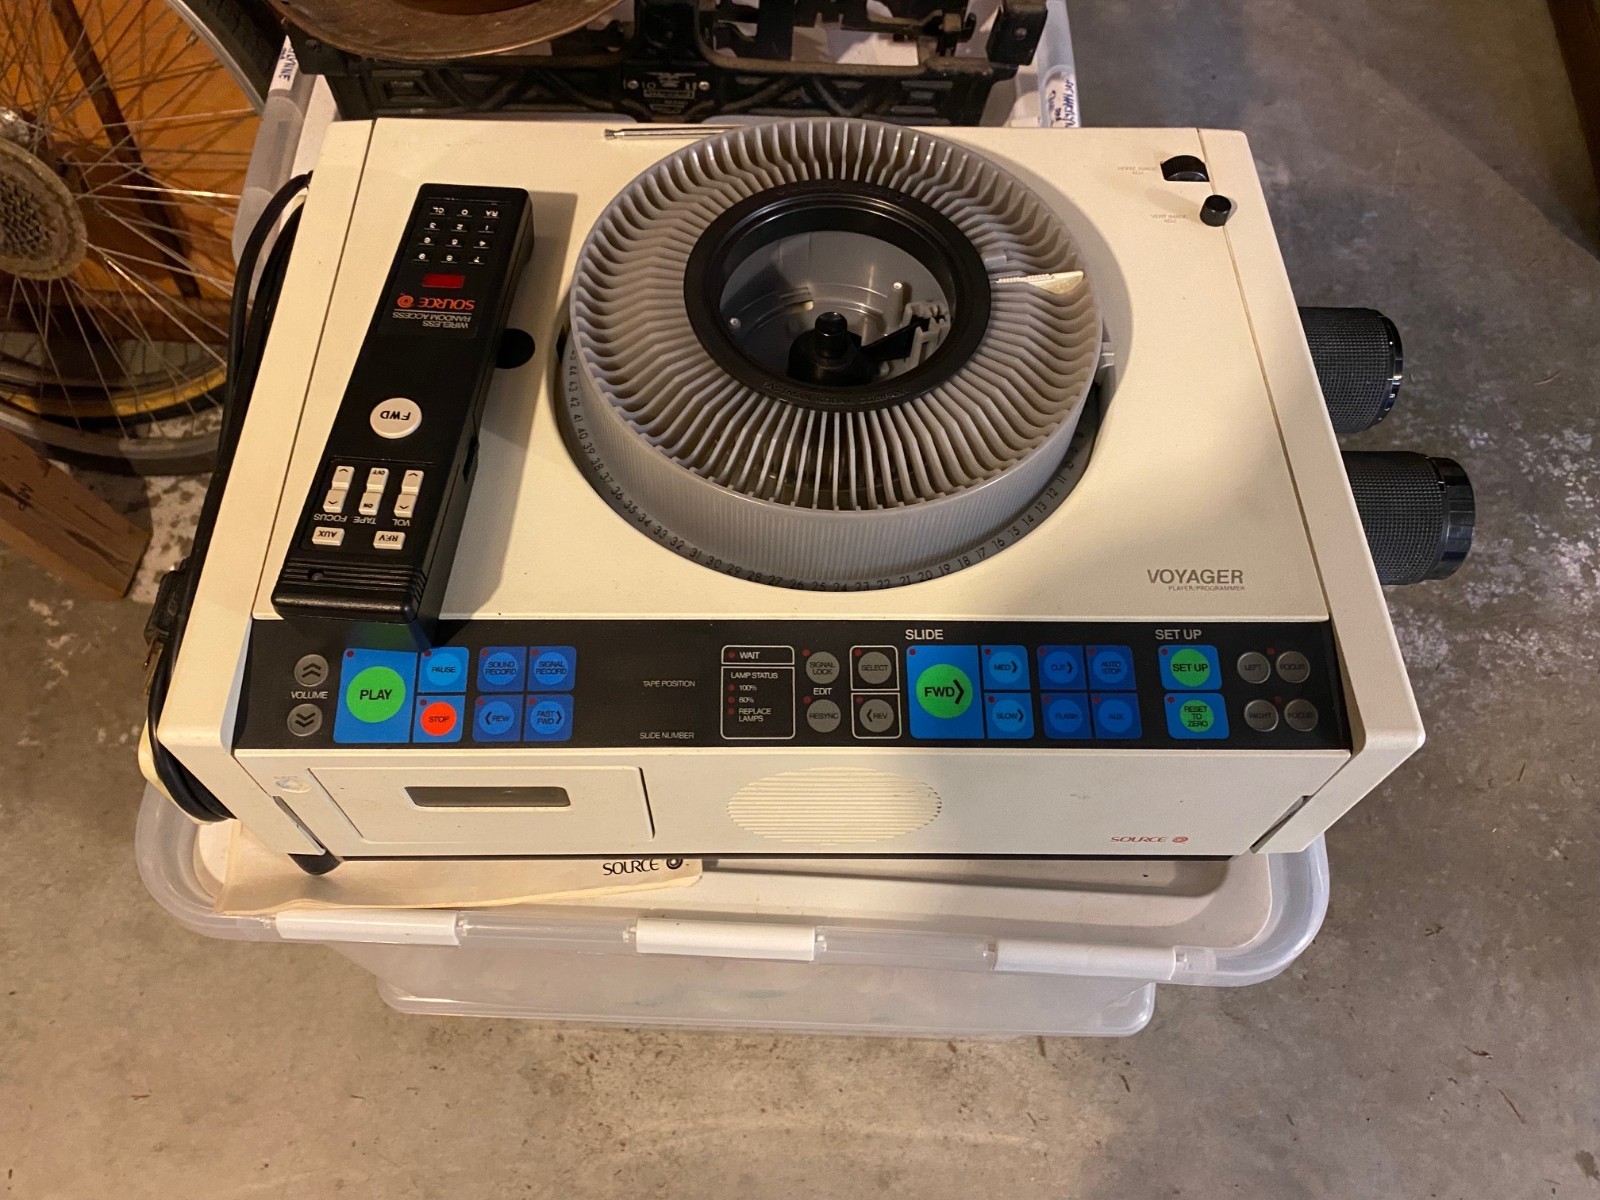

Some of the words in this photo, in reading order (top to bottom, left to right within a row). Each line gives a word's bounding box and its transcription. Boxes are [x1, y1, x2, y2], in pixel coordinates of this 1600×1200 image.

[420, 298, 475, 310] SOURCE
[392, 312, 426, 320] ACCESS
[426, 314, 472, 322] RANDOM
[422, 320, 469, 329] WIRELESS
[380, 410, 412, 420] FWD
[574, 414, 584, 423] 41
[578, 428, 588, 440] 40
[583, 442, 596, 454] 39
[591, 458, 602, 471] 38
[600, 472, 614, 484] 37
[1057, 474, 1066, 484] 11
[612, 487, 624, 500] 36
[1046, 488, 1058, 499] 12
[624, 500, 638, 514] 35
[1034, 502, 1047, 513] 13
[314, 514, 348, 522] FOCUS
[353, 516, 377, 524] TAPE
[392, 518, 410, 526] VOL
[638, 514, 652, 527] 34
[1022, 515, 1034, 526] 14
[653, 526, 668, 540] 33
[1008, 526, 1020, 537] 15
[670, 536, 684, 550] 32
[992, 538, 1004, 549] 16
[690, 548, 702, 558] 31
[975, 548, 986, 559] 17
[706, 556, 722, 568] 30
[957, 556, 970, 568] 18
[726, 564, 742, 576] 29
[938, 564, 950, 575] 19
[748, 570, 762, 582] 28
[768, 576, 782, 586] 27
[900, 576, 910, 585] 21
[918, 570, 932, 581] 20
[1147, 569, 1244, 584] VOYAGER
[790, 579, 804, 589] 26
[812, 582, 826, 590] 25
[834, 582, 848, 592] 24
[856, 582, 870, 590] 23
[877, 579, 890, 588] 22
[905, 630, 944, 640] SLIDE
[1155, 630, 1180, 640] SET
[1184, 630, 1202, 640] UP
[290, 690, 328, 700] VOLUME
[360, 688, 392, 700] PLAY
[924, 686, 956, 698] FWD
[428, 715, 450, 723] STOP
[602, 859, 660, 876] SOURCE
